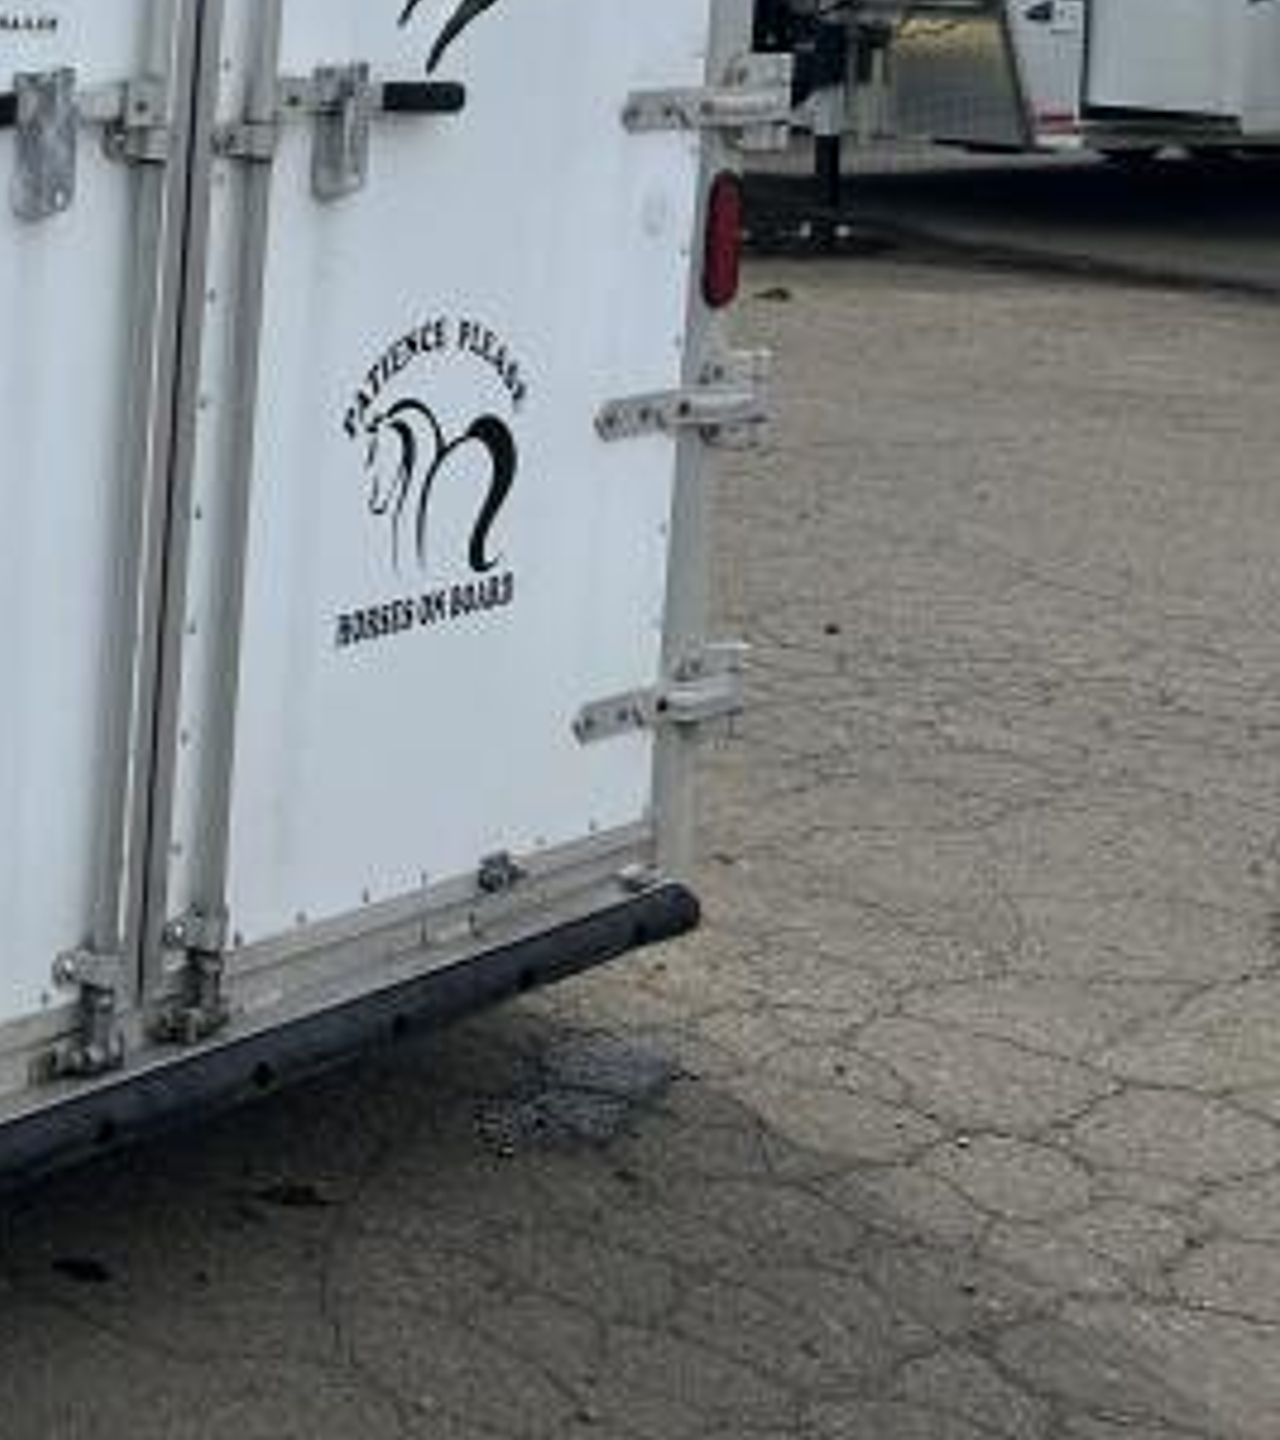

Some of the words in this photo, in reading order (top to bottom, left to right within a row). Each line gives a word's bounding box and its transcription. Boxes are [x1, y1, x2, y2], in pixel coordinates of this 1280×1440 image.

[343, 317, 446, 438] PATIENCE
[458, 320, 527, 411] PLEASE
[335, 598, 414, 647] HORSES
[415, 588, 446, 626] ON
